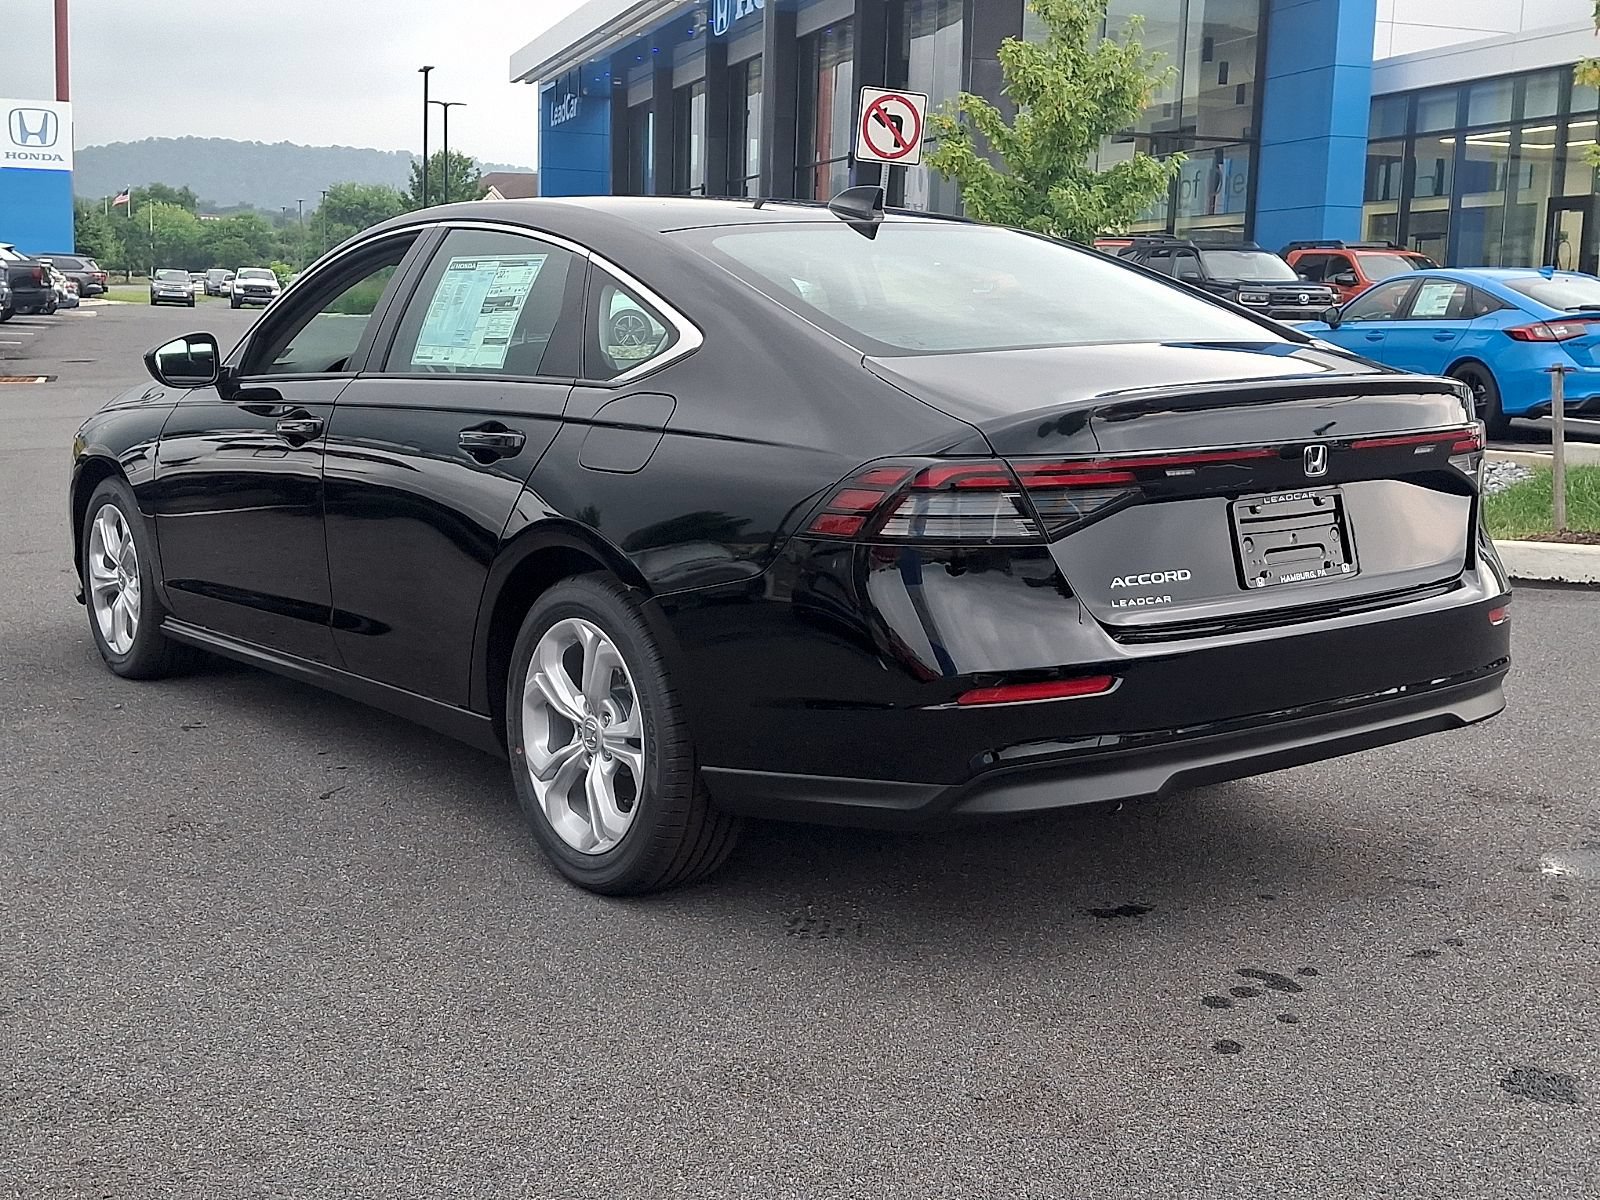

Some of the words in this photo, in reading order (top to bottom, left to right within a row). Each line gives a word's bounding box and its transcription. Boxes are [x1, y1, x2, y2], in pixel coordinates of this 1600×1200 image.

[550, 93, 578, 127] LeadCar
[4, 151, 65, 161] HONDA
[1263, 491, 1317, 504] LEADCAR
[1110, 569, 1192, 589] ACCORD
[1279, 570, 1317, 583] HAMBURG,
[1317, 569, 1328, 577] PA
[1111, 595, 1172, 608] LEADCAR
